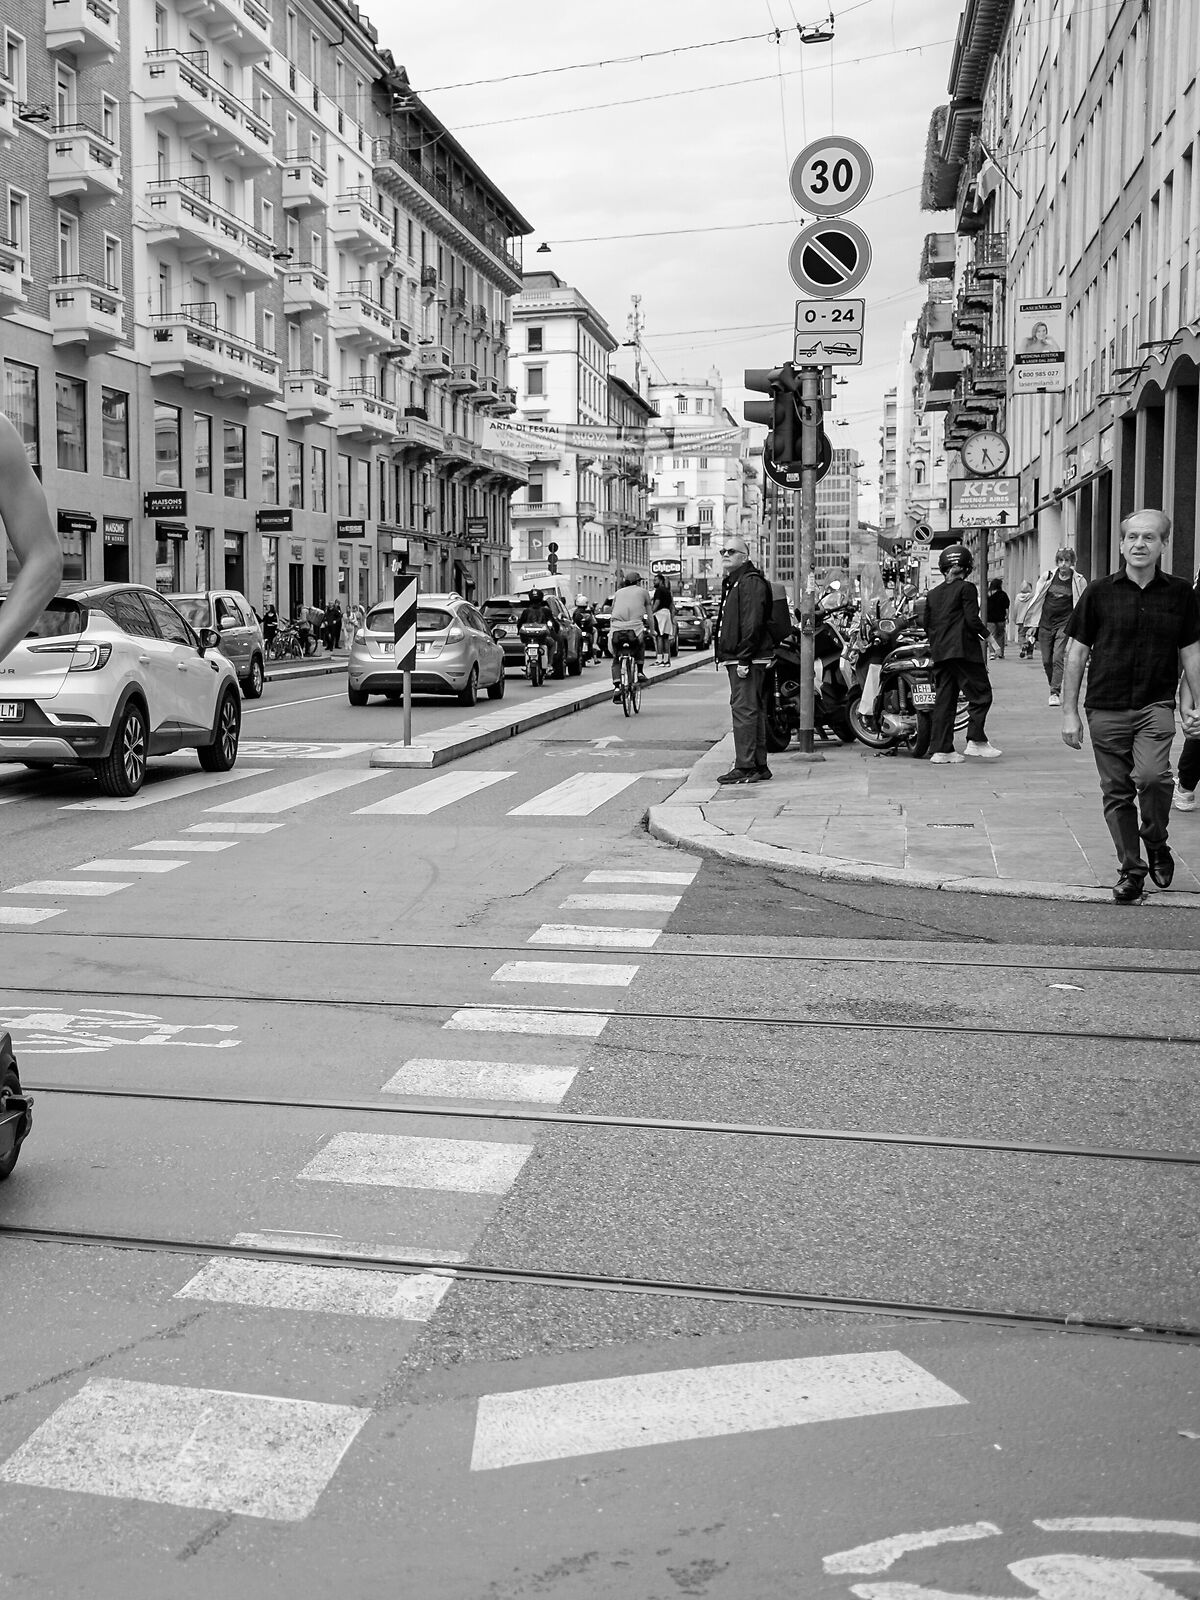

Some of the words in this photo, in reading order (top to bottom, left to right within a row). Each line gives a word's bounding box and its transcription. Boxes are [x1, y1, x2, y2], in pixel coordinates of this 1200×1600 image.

[810, 158, 853, 194] 30
[831, 309, 855, 322] 24
[489, 422, 513, 431] ARIA
[516, 424, 526, 432] DI
[572, 432, 608, 441] NUOVA
[961, 480, 1010, 497] KFC
[105, 523, 125, 533] MAISONS
[652, 560, 681, 572] chicco
